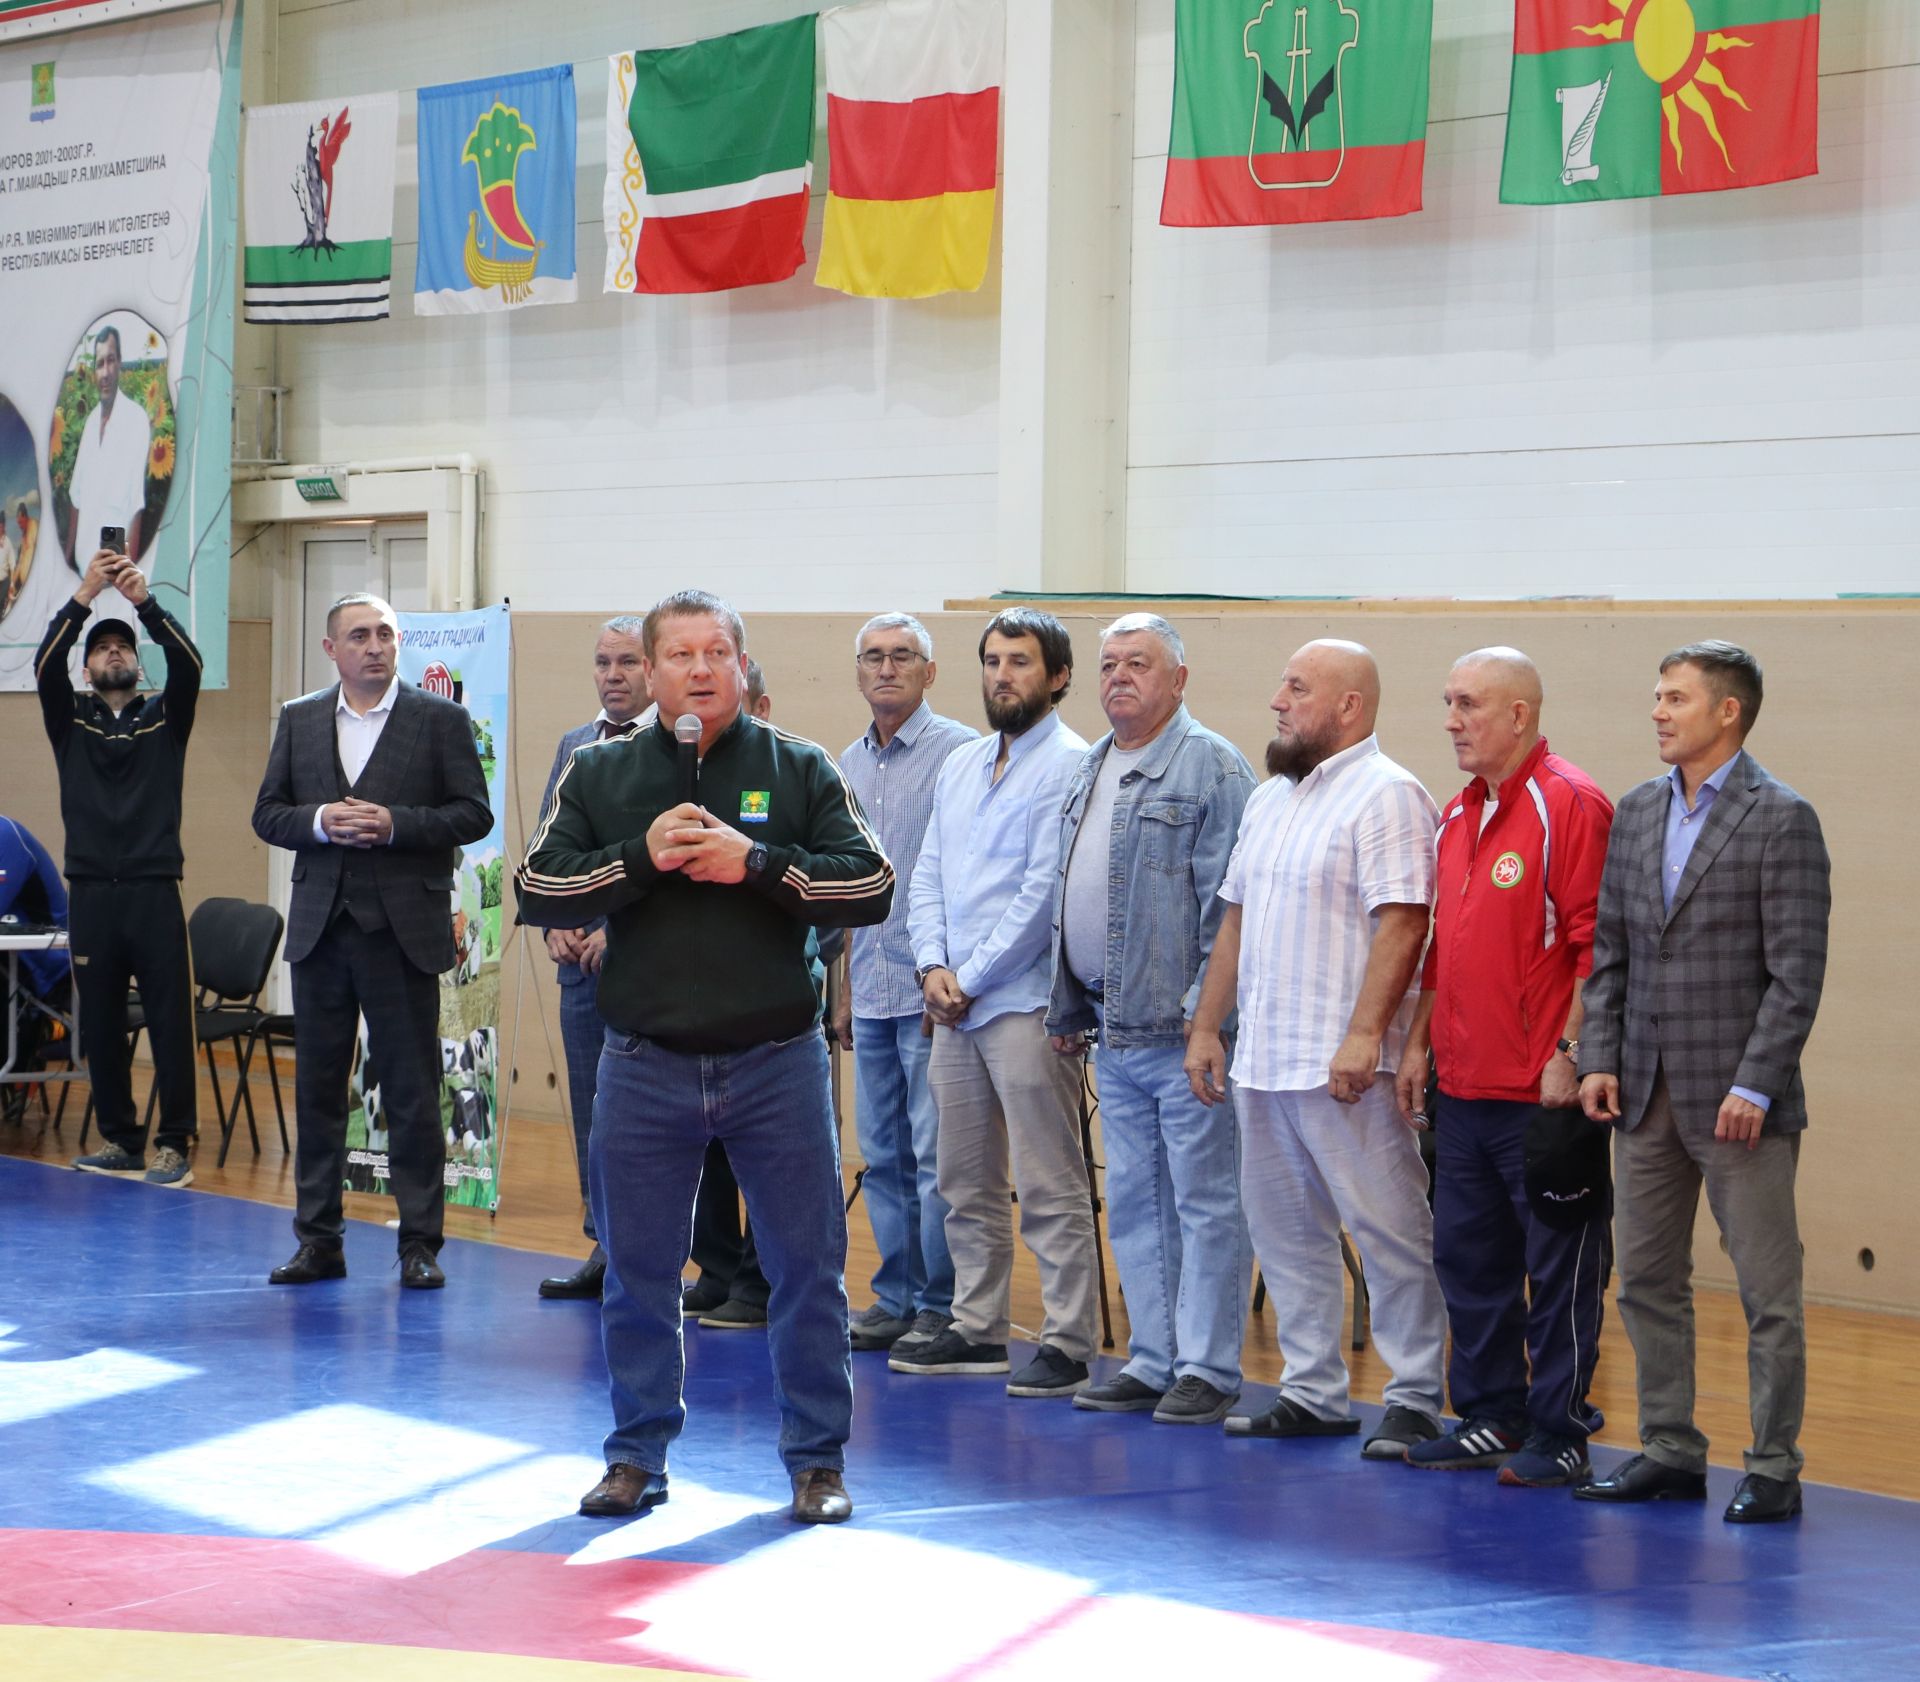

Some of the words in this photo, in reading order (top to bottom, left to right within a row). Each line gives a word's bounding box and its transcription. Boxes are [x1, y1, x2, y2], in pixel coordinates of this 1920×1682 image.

[8, 169, 69, 193] Г.МАМАДЫШ
[71, 153, 167, 183] Р.Я.МУХАМЕТШИНА
[27, 220, 106, 246] МӨХӘММӘТШИН
[108, 210, 170, 235] ИСТӘЛЕГЕНӘ
[2, 247, 82, 272] РЕСПУБЛИКАСЫ
[83, 237, 154, 261] БЕРЕНЧЕЛЕГЕ
